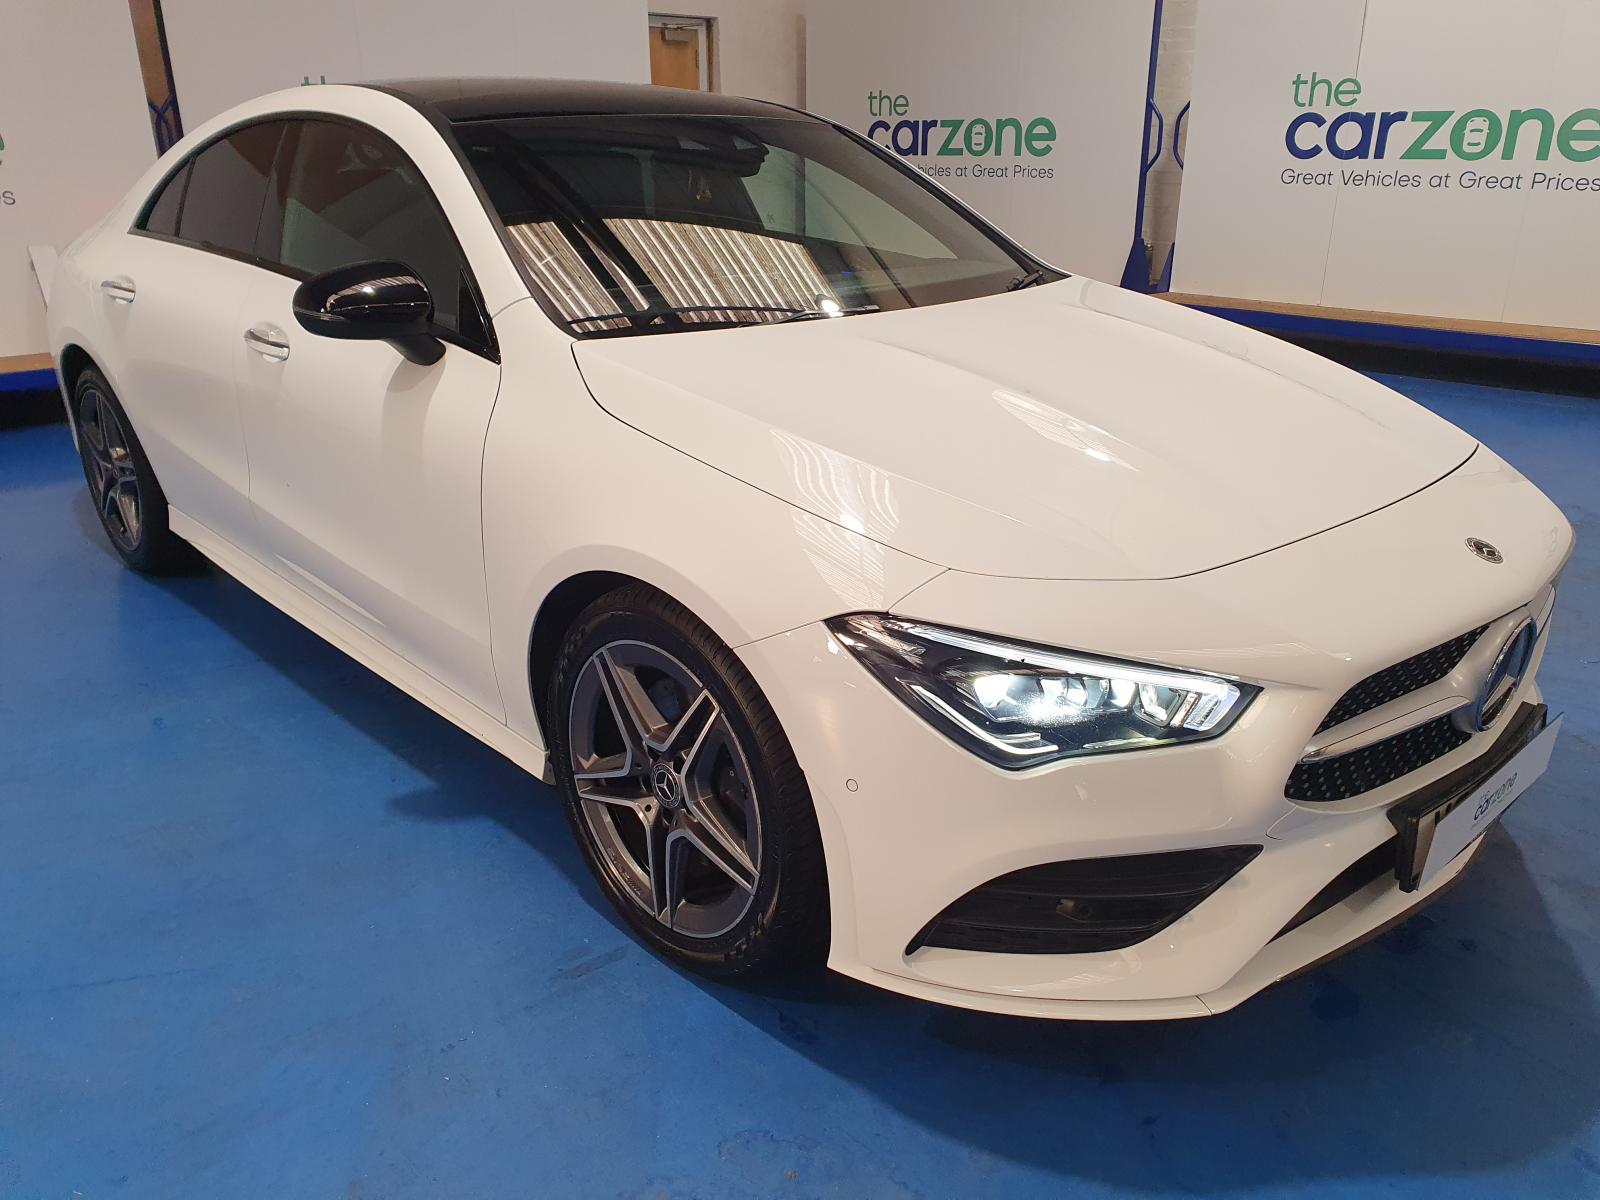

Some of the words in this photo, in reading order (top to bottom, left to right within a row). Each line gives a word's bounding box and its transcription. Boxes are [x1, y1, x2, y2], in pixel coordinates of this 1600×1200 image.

[1292, 72, 1361, 107] the
[868, 90, 909, 116] the
[1285, 108, 1600, 163] carzone
[955, 165, 968, 177] at
[972, 163, 1008, 178] Great
[1013, 164, 1054, 179] Prices
[1280, 168, 1333, 186] Great
[1341, 169, 1422, 188] Vehicles
[1429, 172, 1451, 188] at
[1458, 171, 1523, 190] Great
[1531, 172, 1600, 192] Prices
